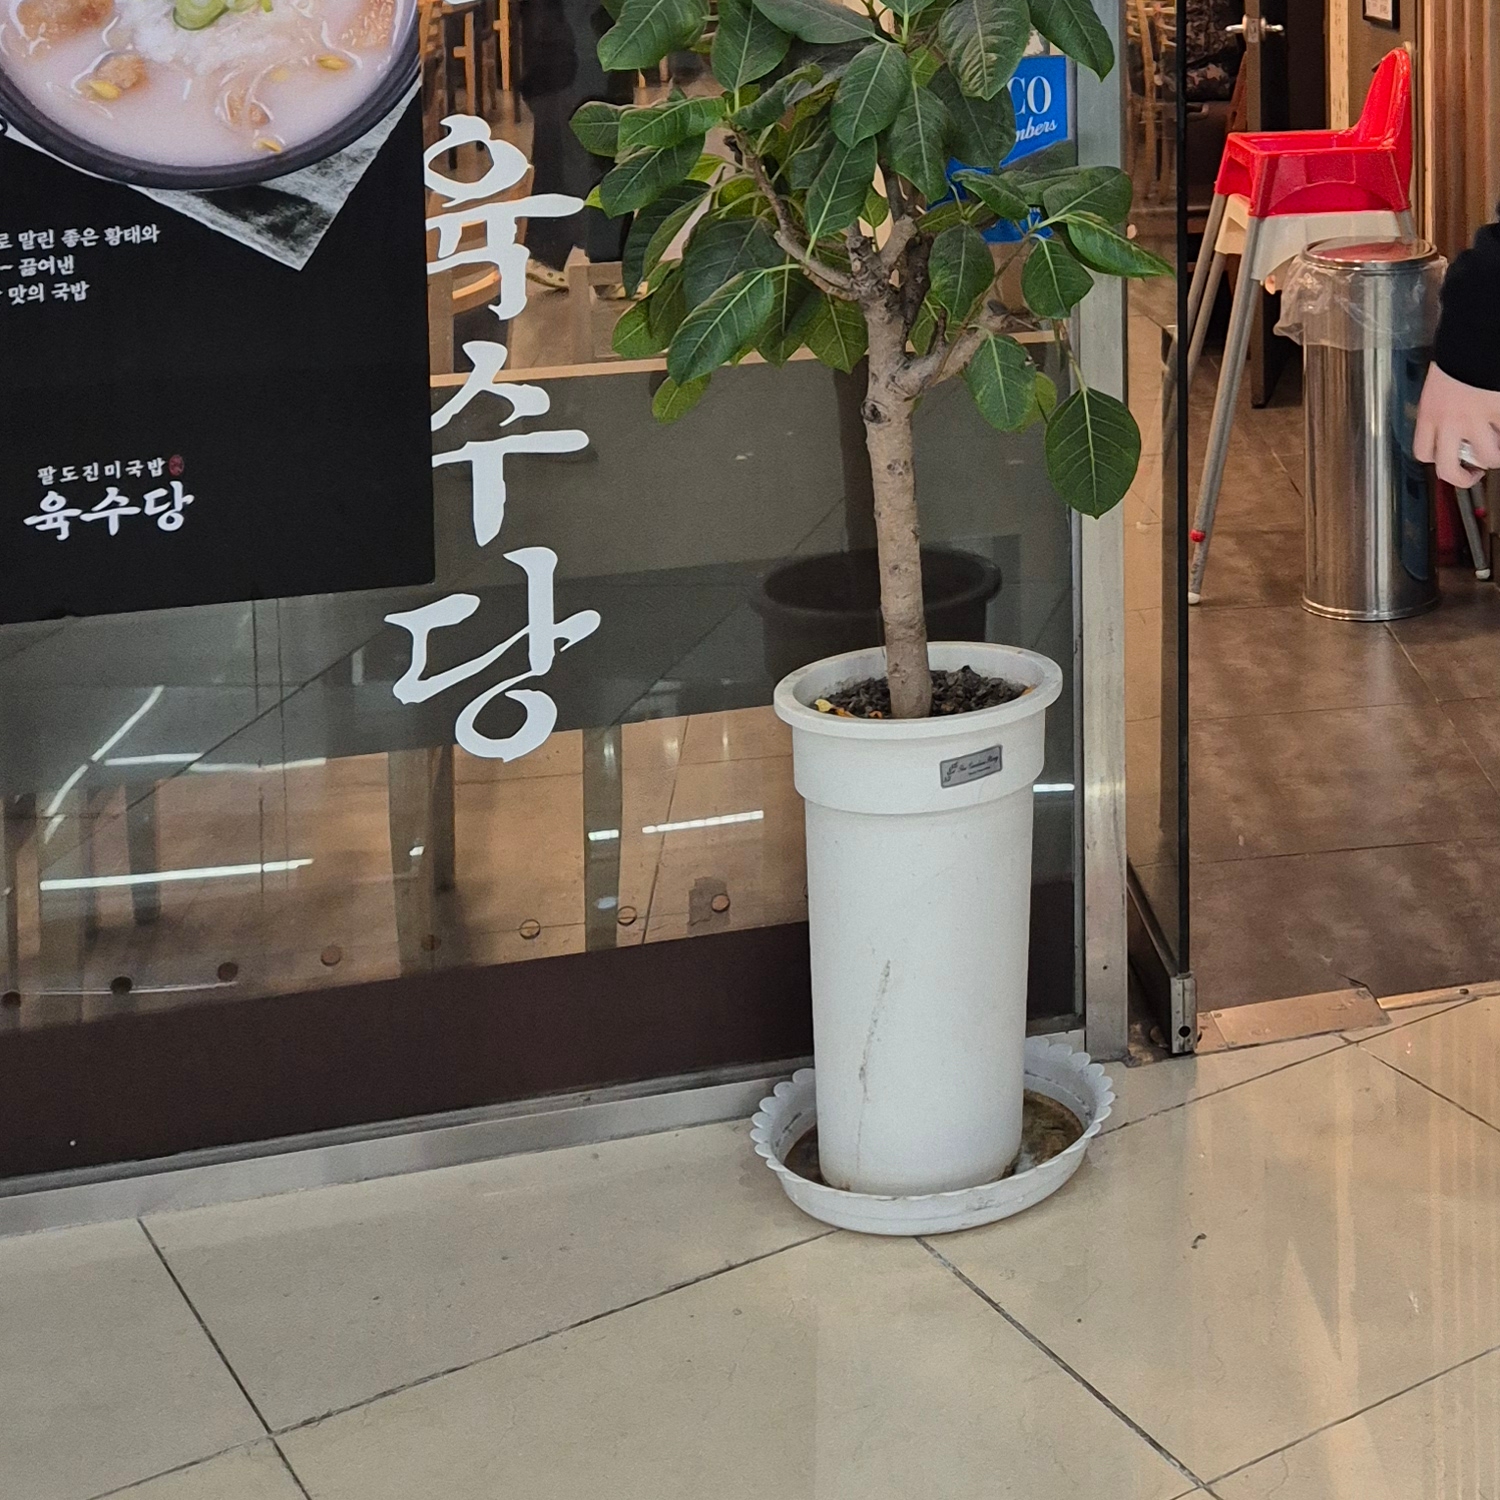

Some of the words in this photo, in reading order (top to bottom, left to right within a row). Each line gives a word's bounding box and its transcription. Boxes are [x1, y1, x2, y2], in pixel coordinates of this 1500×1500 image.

[18, 228, 55, 251] 말린
[61, 227, 100, 248] 좋은
[104, 223, 161, 246] 황태와
[8, 281, 45, 306] 맛의
[51, 280, 91, 302] 국밥
[37, 457, 168, 486] 팔도진미국밥
[23, 480, 195, 541] 육수당
